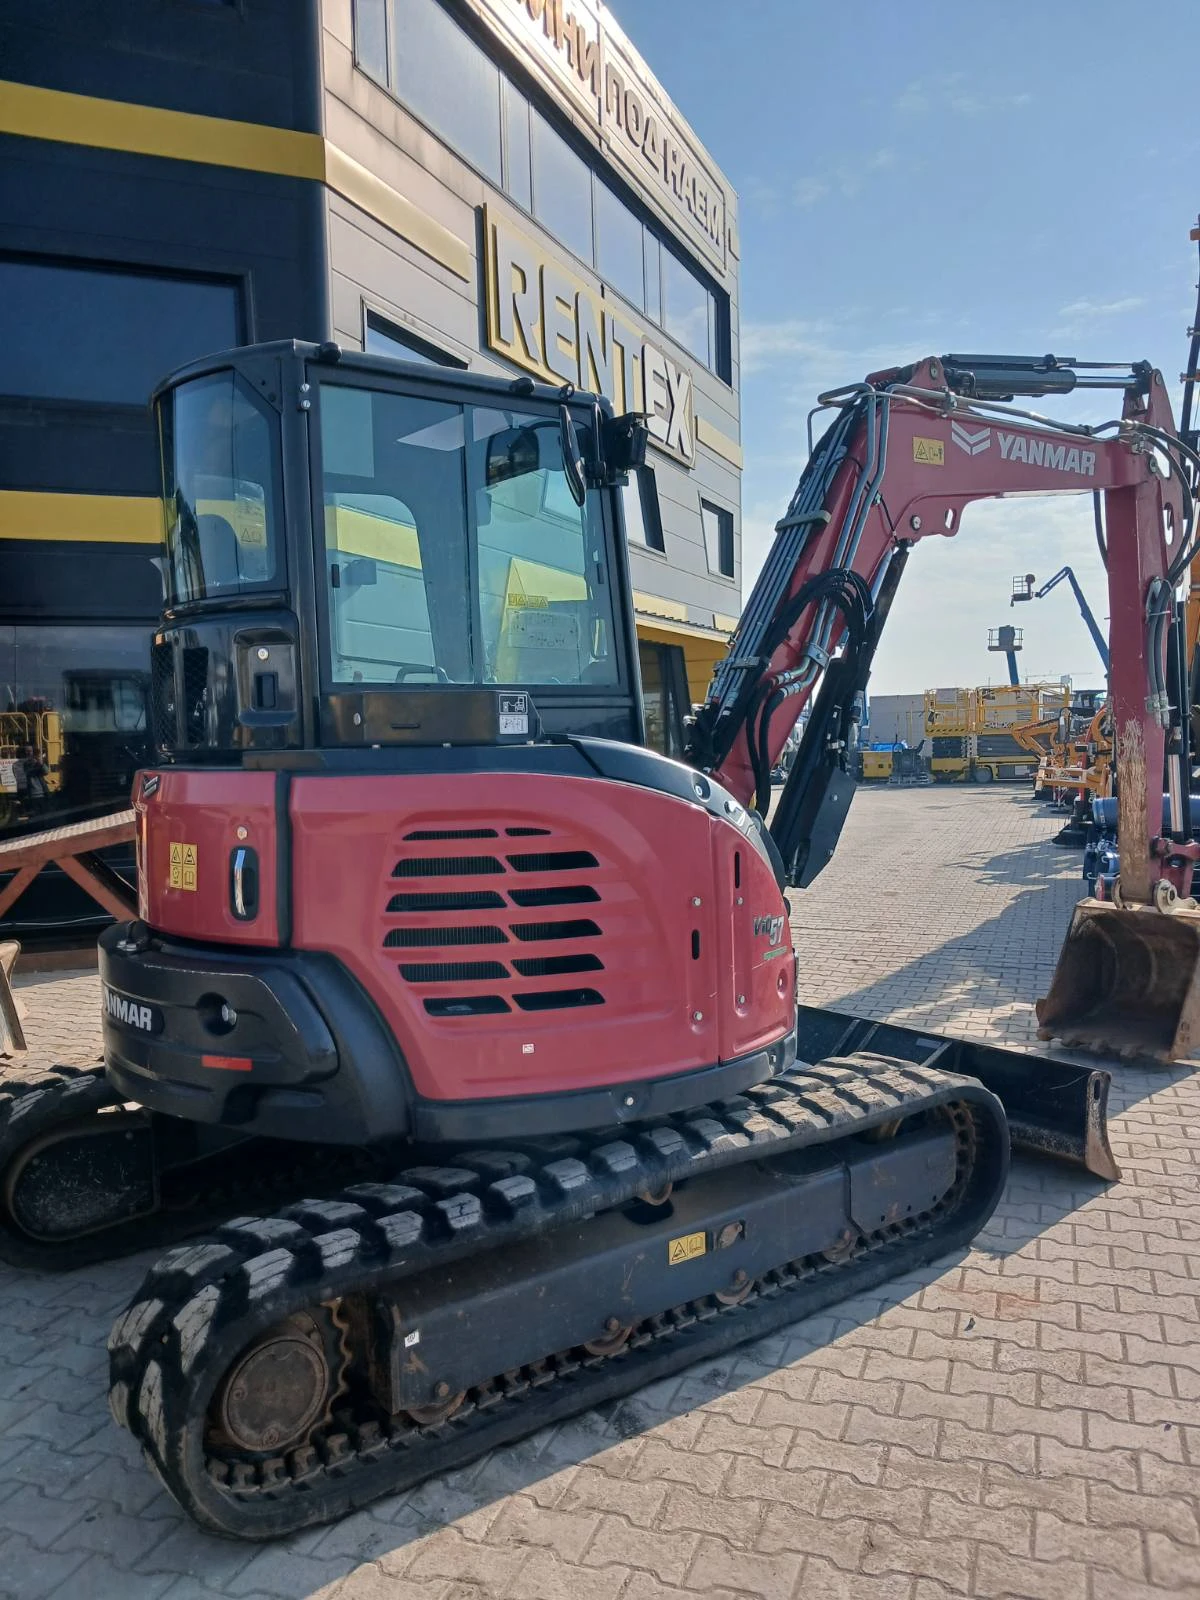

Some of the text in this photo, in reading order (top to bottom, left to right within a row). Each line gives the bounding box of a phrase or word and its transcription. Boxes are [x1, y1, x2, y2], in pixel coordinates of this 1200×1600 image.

[605, 62, 660, 174] ПОД
[662, 137, 720, 247] НАЕМ
[491, 222, 692, 458] RENTEX
[997, 432, 1096, 476] YANMAR
[104, 986, 152, 1031] ANMAR
